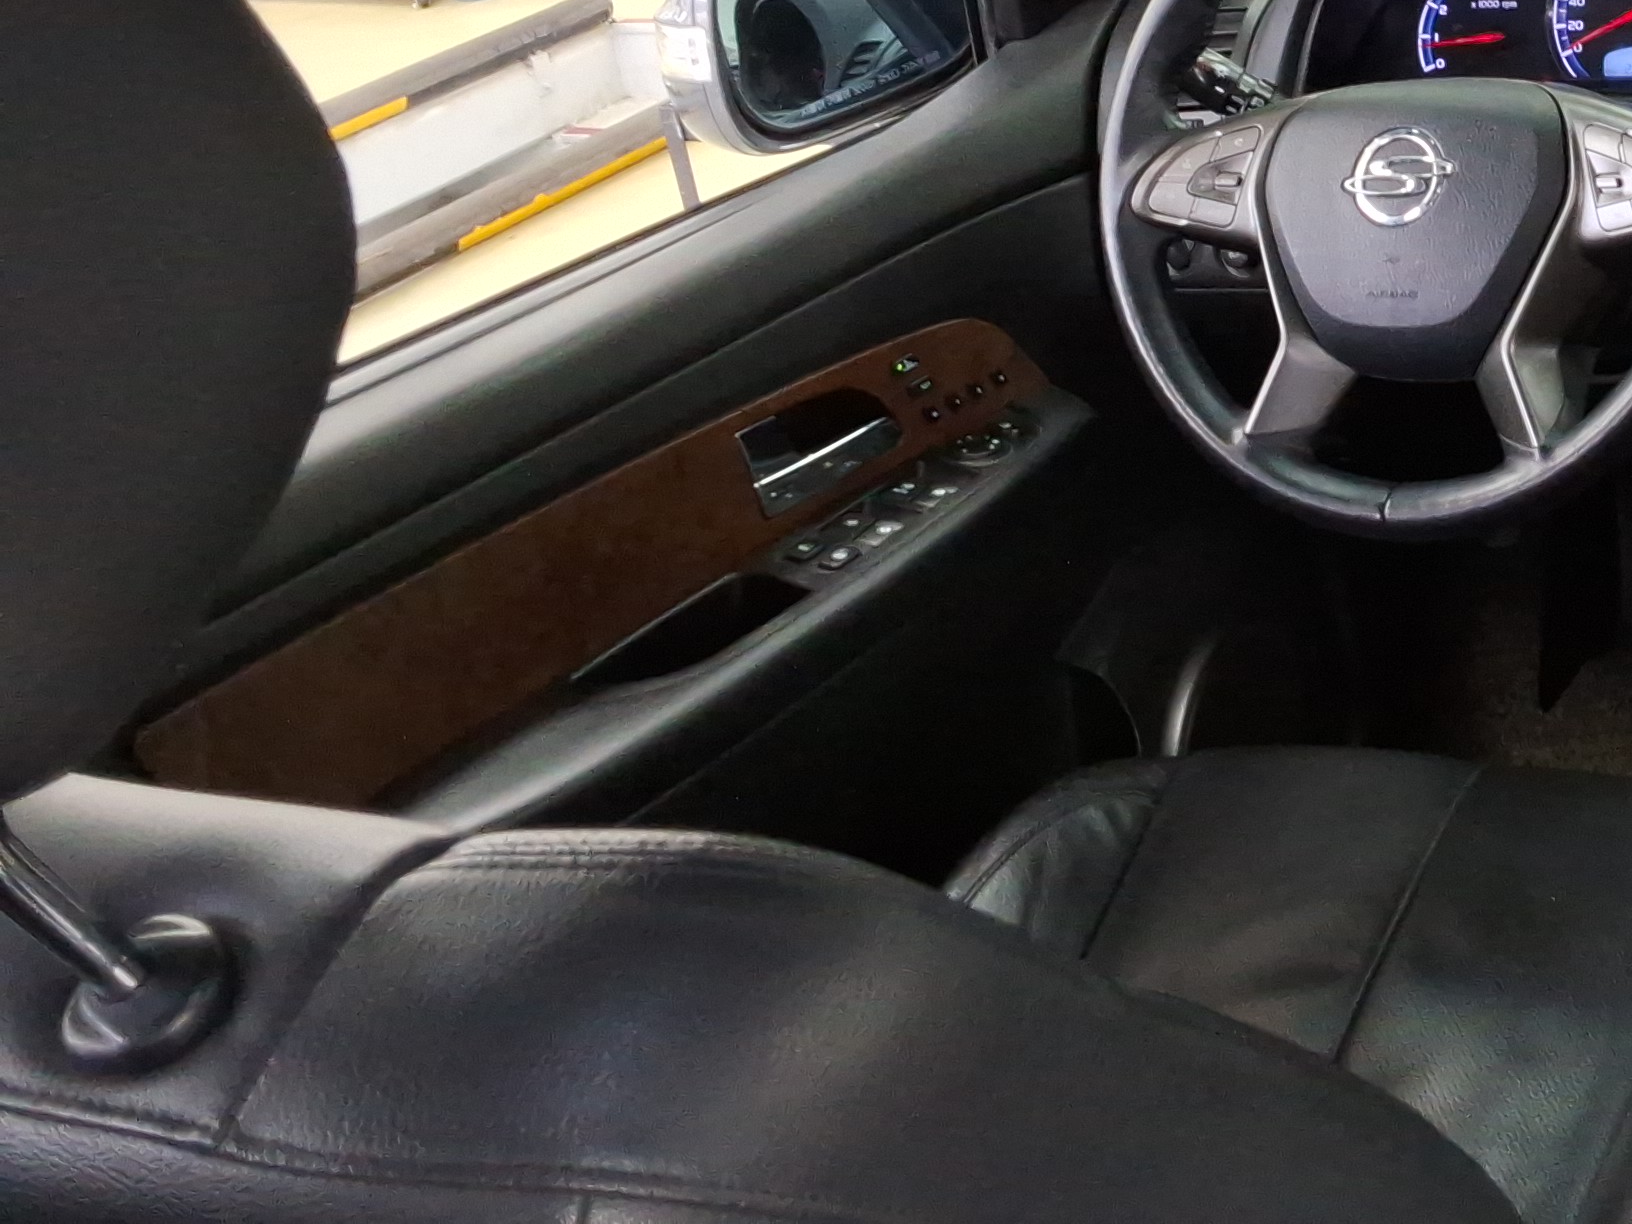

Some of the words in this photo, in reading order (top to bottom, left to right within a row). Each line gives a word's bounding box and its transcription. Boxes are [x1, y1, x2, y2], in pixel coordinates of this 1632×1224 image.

[1438, 5, 1447, 15] 2
[1567, 20, 1584, 31] 20
[1436, 58, 1445, 69] 0
